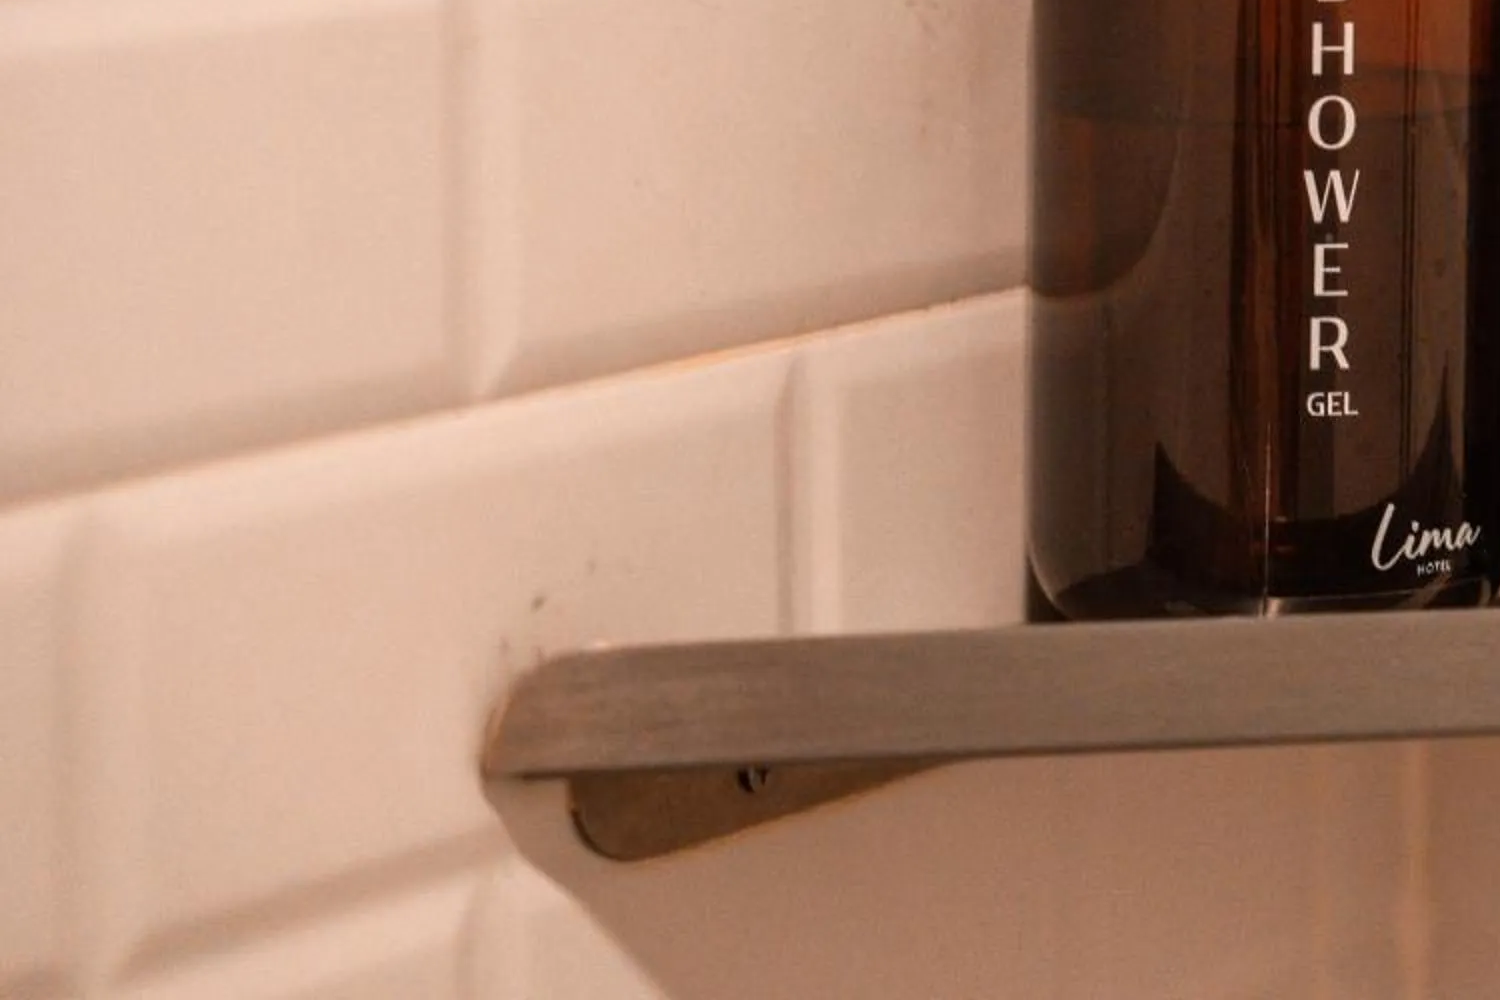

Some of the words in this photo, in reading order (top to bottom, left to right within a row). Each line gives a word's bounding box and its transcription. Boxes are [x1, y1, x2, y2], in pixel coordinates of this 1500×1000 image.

[1306, 391, 1359, 417] GEL
[1372, 503, 1481, 571] Lima
[1416, 559, 1451, 576] HOTEL
